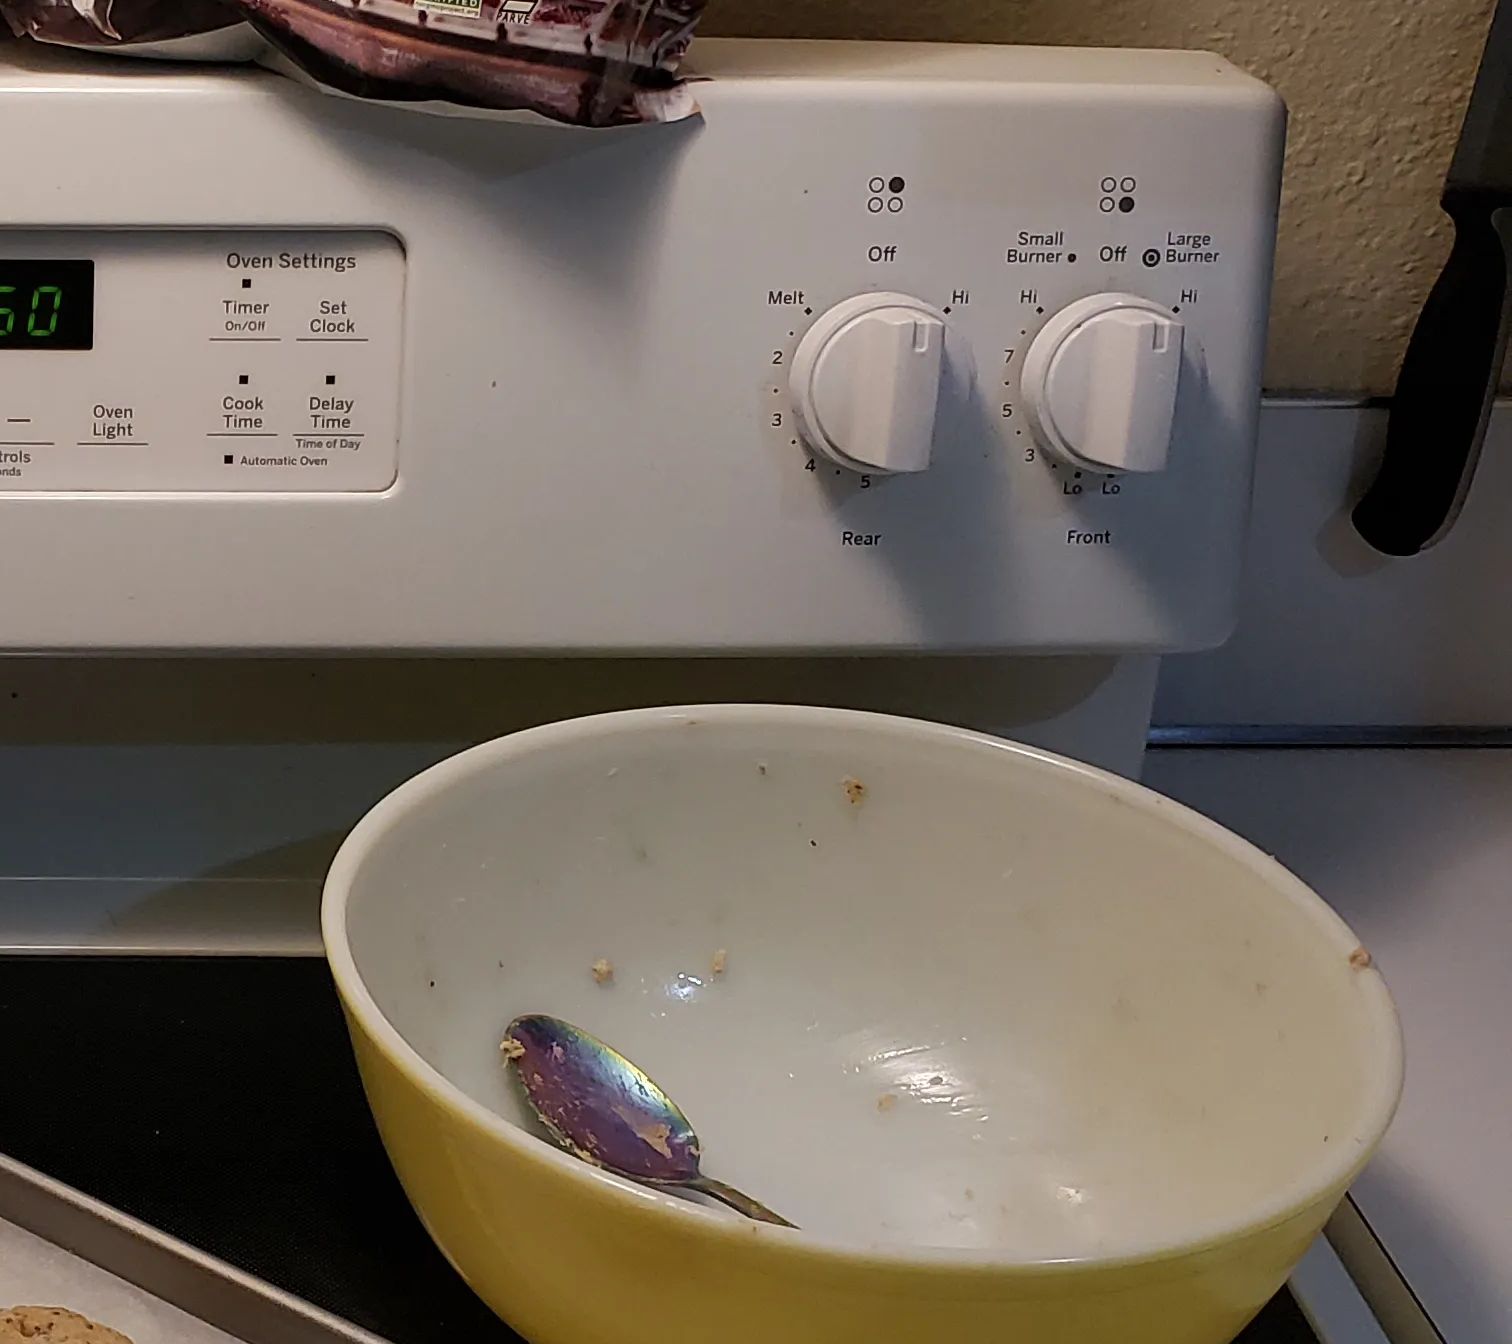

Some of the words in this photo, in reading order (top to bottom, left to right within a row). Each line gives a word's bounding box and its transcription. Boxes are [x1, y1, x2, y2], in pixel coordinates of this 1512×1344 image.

[496, 12, 530, 25] PARVE
[1018, 231, 1064, 246] Small
[1167, 232, 1211, 248] Large
[868, 247, 897, 262] Off
[1006, 249, 1062, 264] Burner
[1099, 246, 1127, 262] Off
[1166, 249, 1220, 263] Burner
[227, 253, 273, 269] Oven
[279, 253, 356, 272] Settings
[768, 290, 804, 305] Melt
[952, 290, 969, 304] Hi
[1020, 290, 1038, 304] Hi
[1180, 289, 1198, 304] Hi
[222, 300, 269, 315] Timer
[319, 301, 347, 315] Set
[225, 320, 265, 332] On/Off
[310, 319, 355, 334] Clock
[772, 351, 783, 364] 2
[1004, 350, 1015, 363] 7
[223, 396, 264, 411] Cook
[309, 397, 354, 415] Delay
[93, 405, 133, 419] Oven
[1002, 404, 1012, 418] 5
[223, 415, 263, 429] Time
[310, 415, 351, 429] Time
[772, 413, 782, 427] 3
[93, 423, 133, 439] Light
[296, 439, 323, 449] Time
[325, 439, 336, 449] of
[339, 439, 361, 452] Day
[240, 456, 296, 467] Automatic
[300, 456, 328, 467] Oven
[1025, 449, 1035, 462] 3
[805, 458, 816, 472] 4
[860, 475, 871, 489] 5
[1063, 481, 1083, 495] Lo
[1102, 481, 1121, 495] Lo
[841, 532, 881, 546] Rear
[1066, 530, 1111, 544] Front
